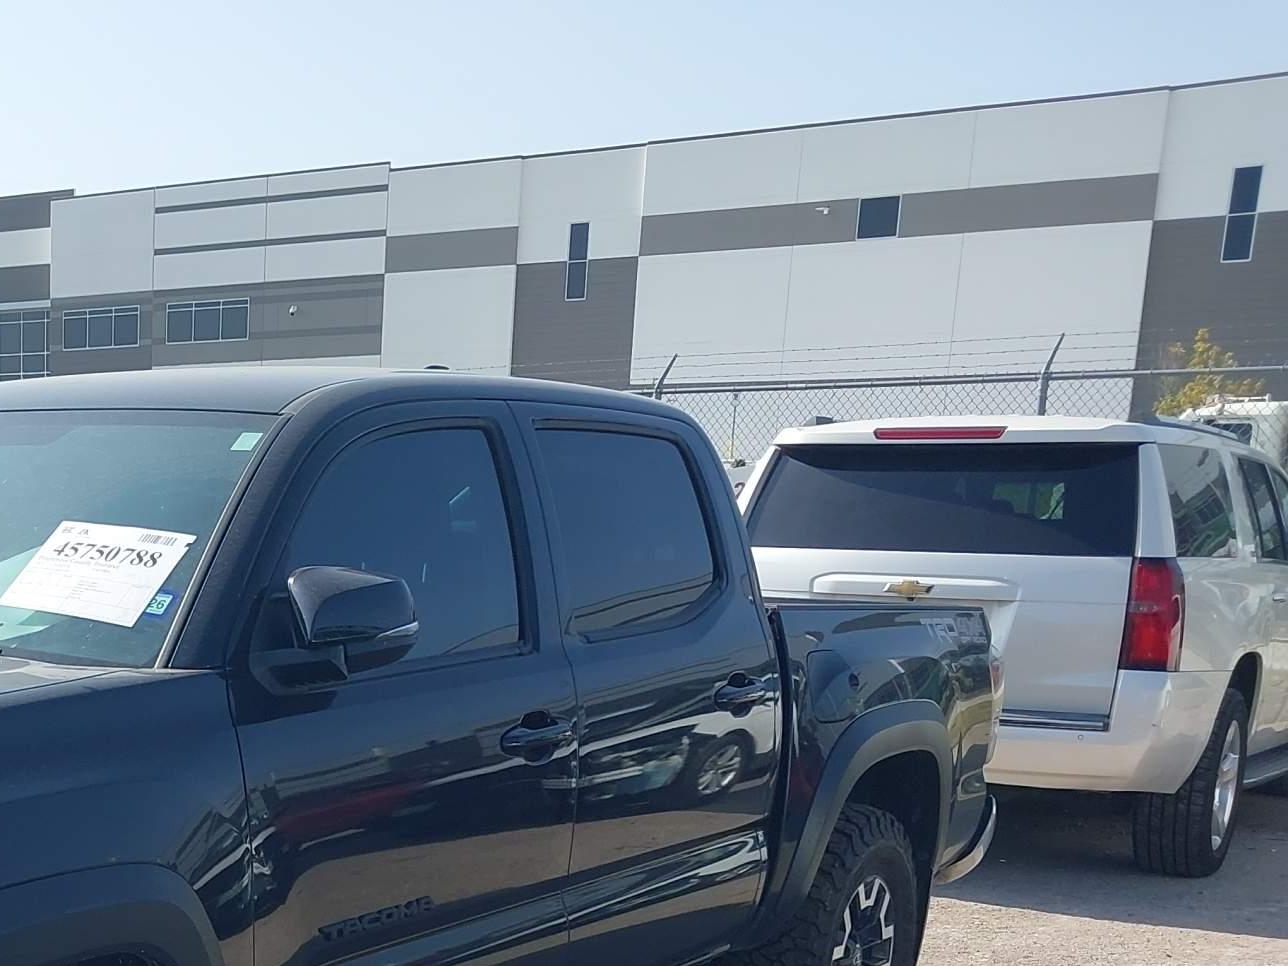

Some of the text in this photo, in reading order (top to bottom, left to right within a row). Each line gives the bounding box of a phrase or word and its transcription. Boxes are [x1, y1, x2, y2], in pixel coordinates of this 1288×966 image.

[54, 541, 163, 568] 45750788
[149, 599, 167, 610] 26
[920, 617, 959, 643] TRD
[317, 895, 436, 941] TACOMA
